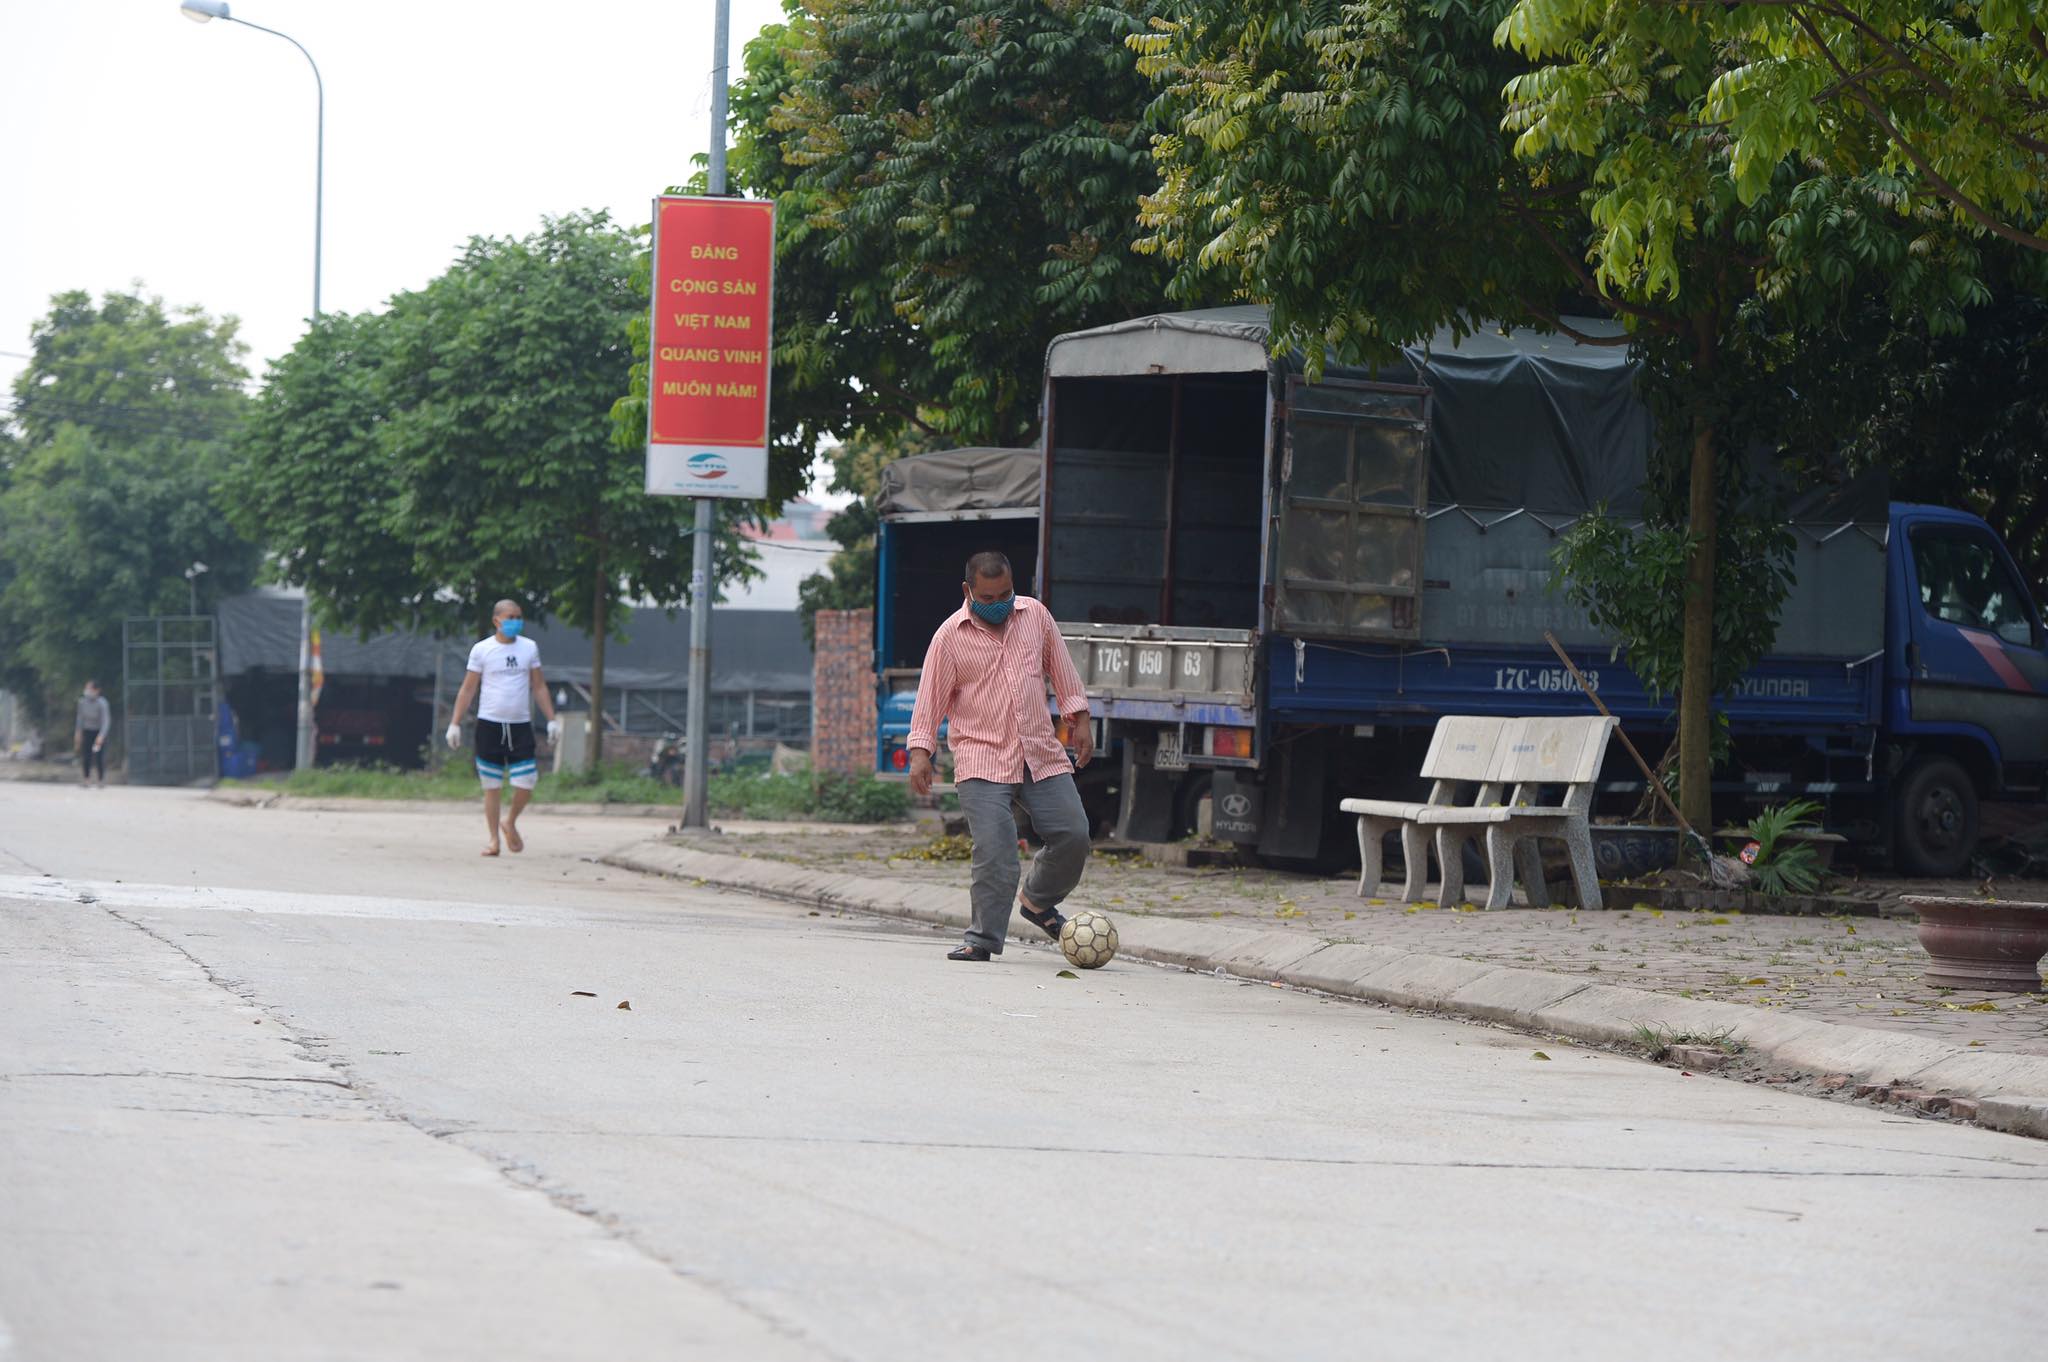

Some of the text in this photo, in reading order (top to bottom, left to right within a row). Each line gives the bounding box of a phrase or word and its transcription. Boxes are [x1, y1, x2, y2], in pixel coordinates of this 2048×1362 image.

[691, 243, 738, 260] ĐẢNG
[723, 277, 757, 295] SẢN
[674, 312, 751, 331] VIỆT NAM
[660, 346, 762, 364] QUANG VINH
[663, 379, 758, 398] MUÔN NĂM!
[1139, 650, 1162, 674] 050
[1183, 651, 1201, 676] 63
